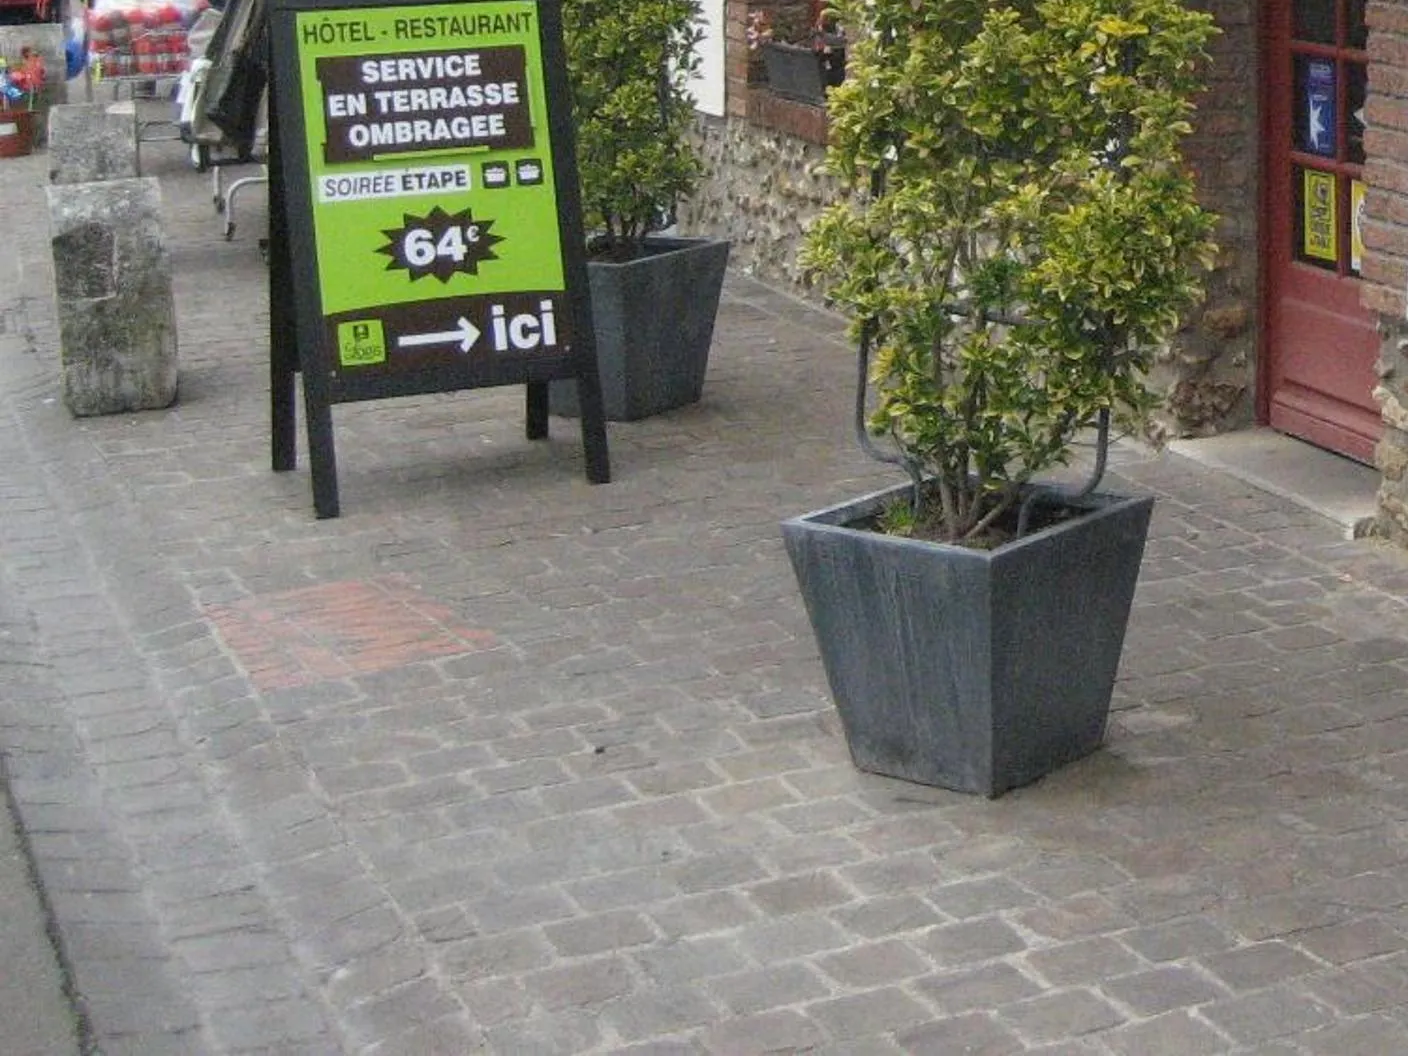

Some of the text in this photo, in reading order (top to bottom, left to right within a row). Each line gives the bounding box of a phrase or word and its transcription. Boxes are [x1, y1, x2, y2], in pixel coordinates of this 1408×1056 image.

[303, 16, 375, 45] HÔTEL
[395, 12, 533, 41] RESTAURANT
[361, 53, 482, 84] SERVICE
[328, 82, 519, 117] EN TERRASSE
[349, 113, 507, 147] OMBRAGEE
[492, 299, 556, 351] ici
